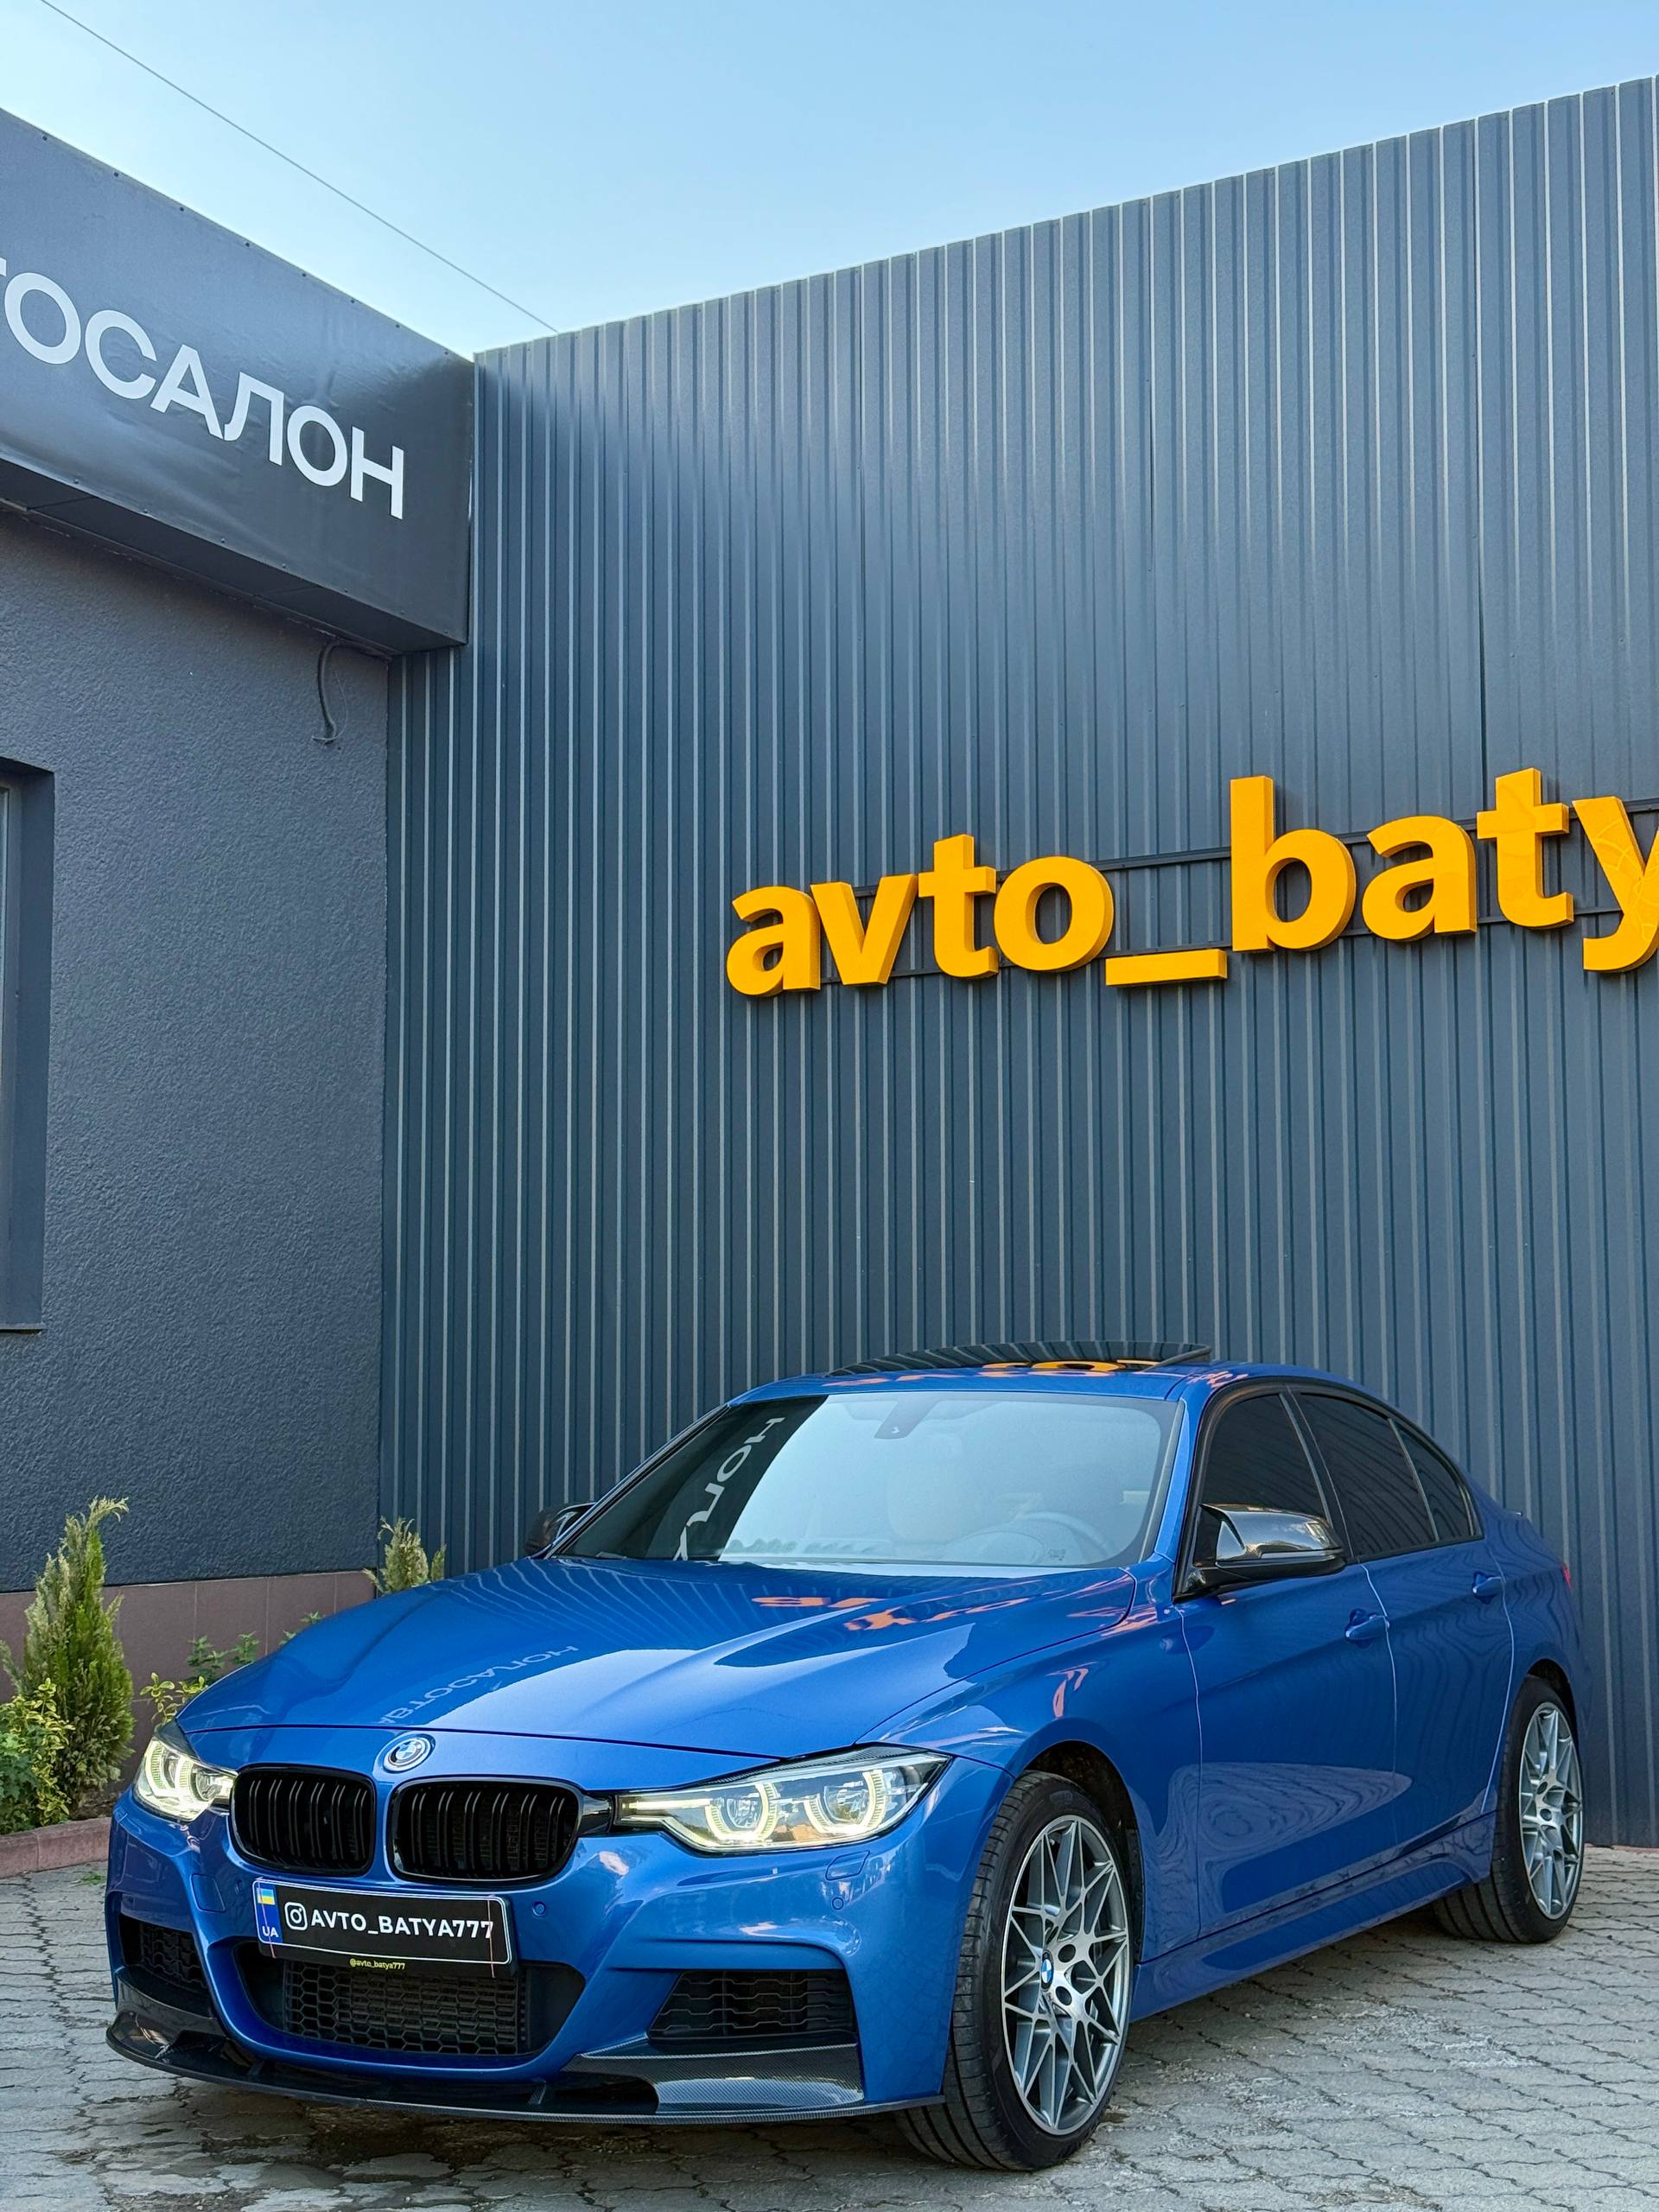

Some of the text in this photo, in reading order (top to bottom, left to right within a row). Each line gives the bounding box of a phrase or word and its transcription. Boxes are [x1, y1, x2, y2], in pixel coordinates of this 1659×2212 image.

[0, 257, 404, 520] ОСАЛОН
[726, 766, 1659, 998] avto_baty
[262, 1925, 279, 1939] UA
[310, 1909, 494, 1939] AVTO_BATYA777
